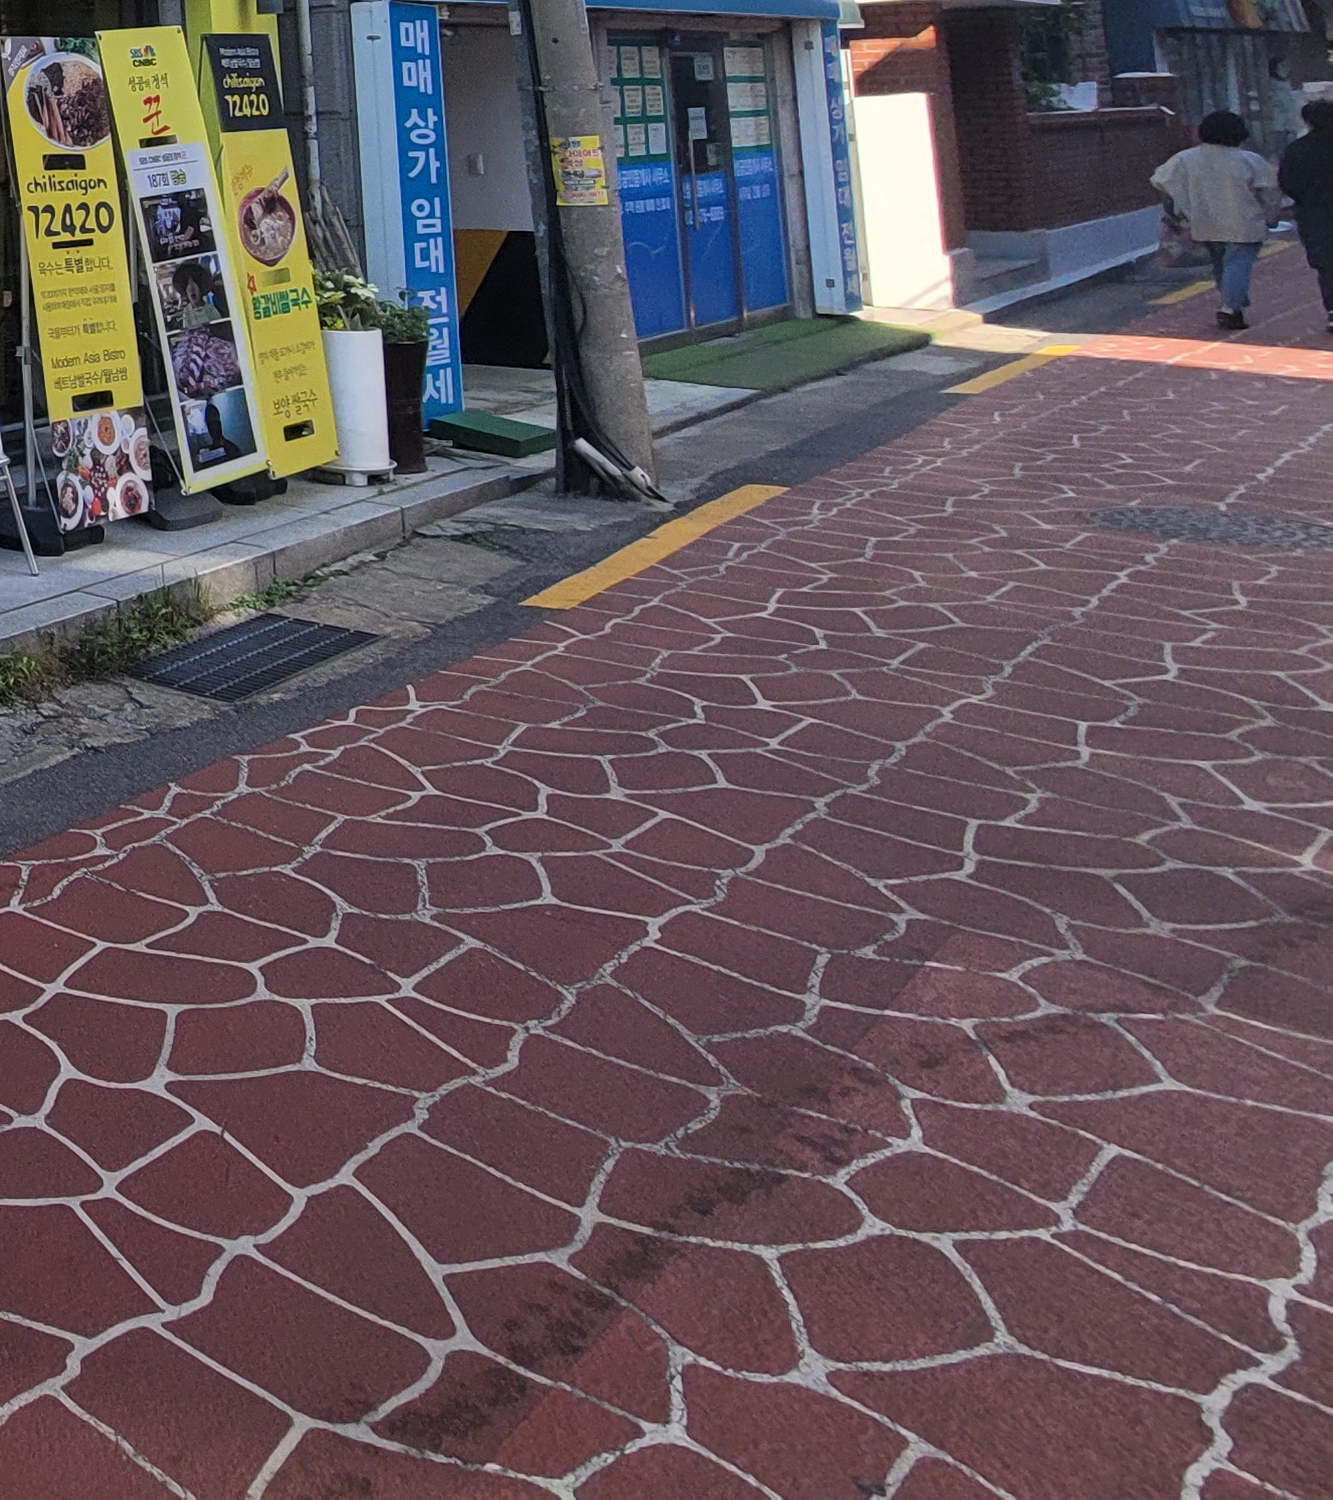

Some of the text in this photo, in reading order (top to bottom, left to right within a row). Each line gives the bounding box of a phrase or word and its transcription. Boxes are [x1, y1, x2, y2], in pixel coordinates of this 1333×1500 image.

[132, 58, 158, 68] CNBC
[399, 19, 433, 95] 매매
[151, 73, 169, 89] 정석
[222, 71, 266, 93] chilisaigon
[142, 94, 171, 136] 꾼
[224, 93, 270, 118] 72420
[404, 107, 438, 185] 상가
[26, 173, 108, 197] chilisaigon
[147, 171, 170, 189] 187회
[26, 201, 116, 240] 72420
[410, 197, 445, 274] 임대
[51, 349, 126, 370] Modern Asia Bistro
